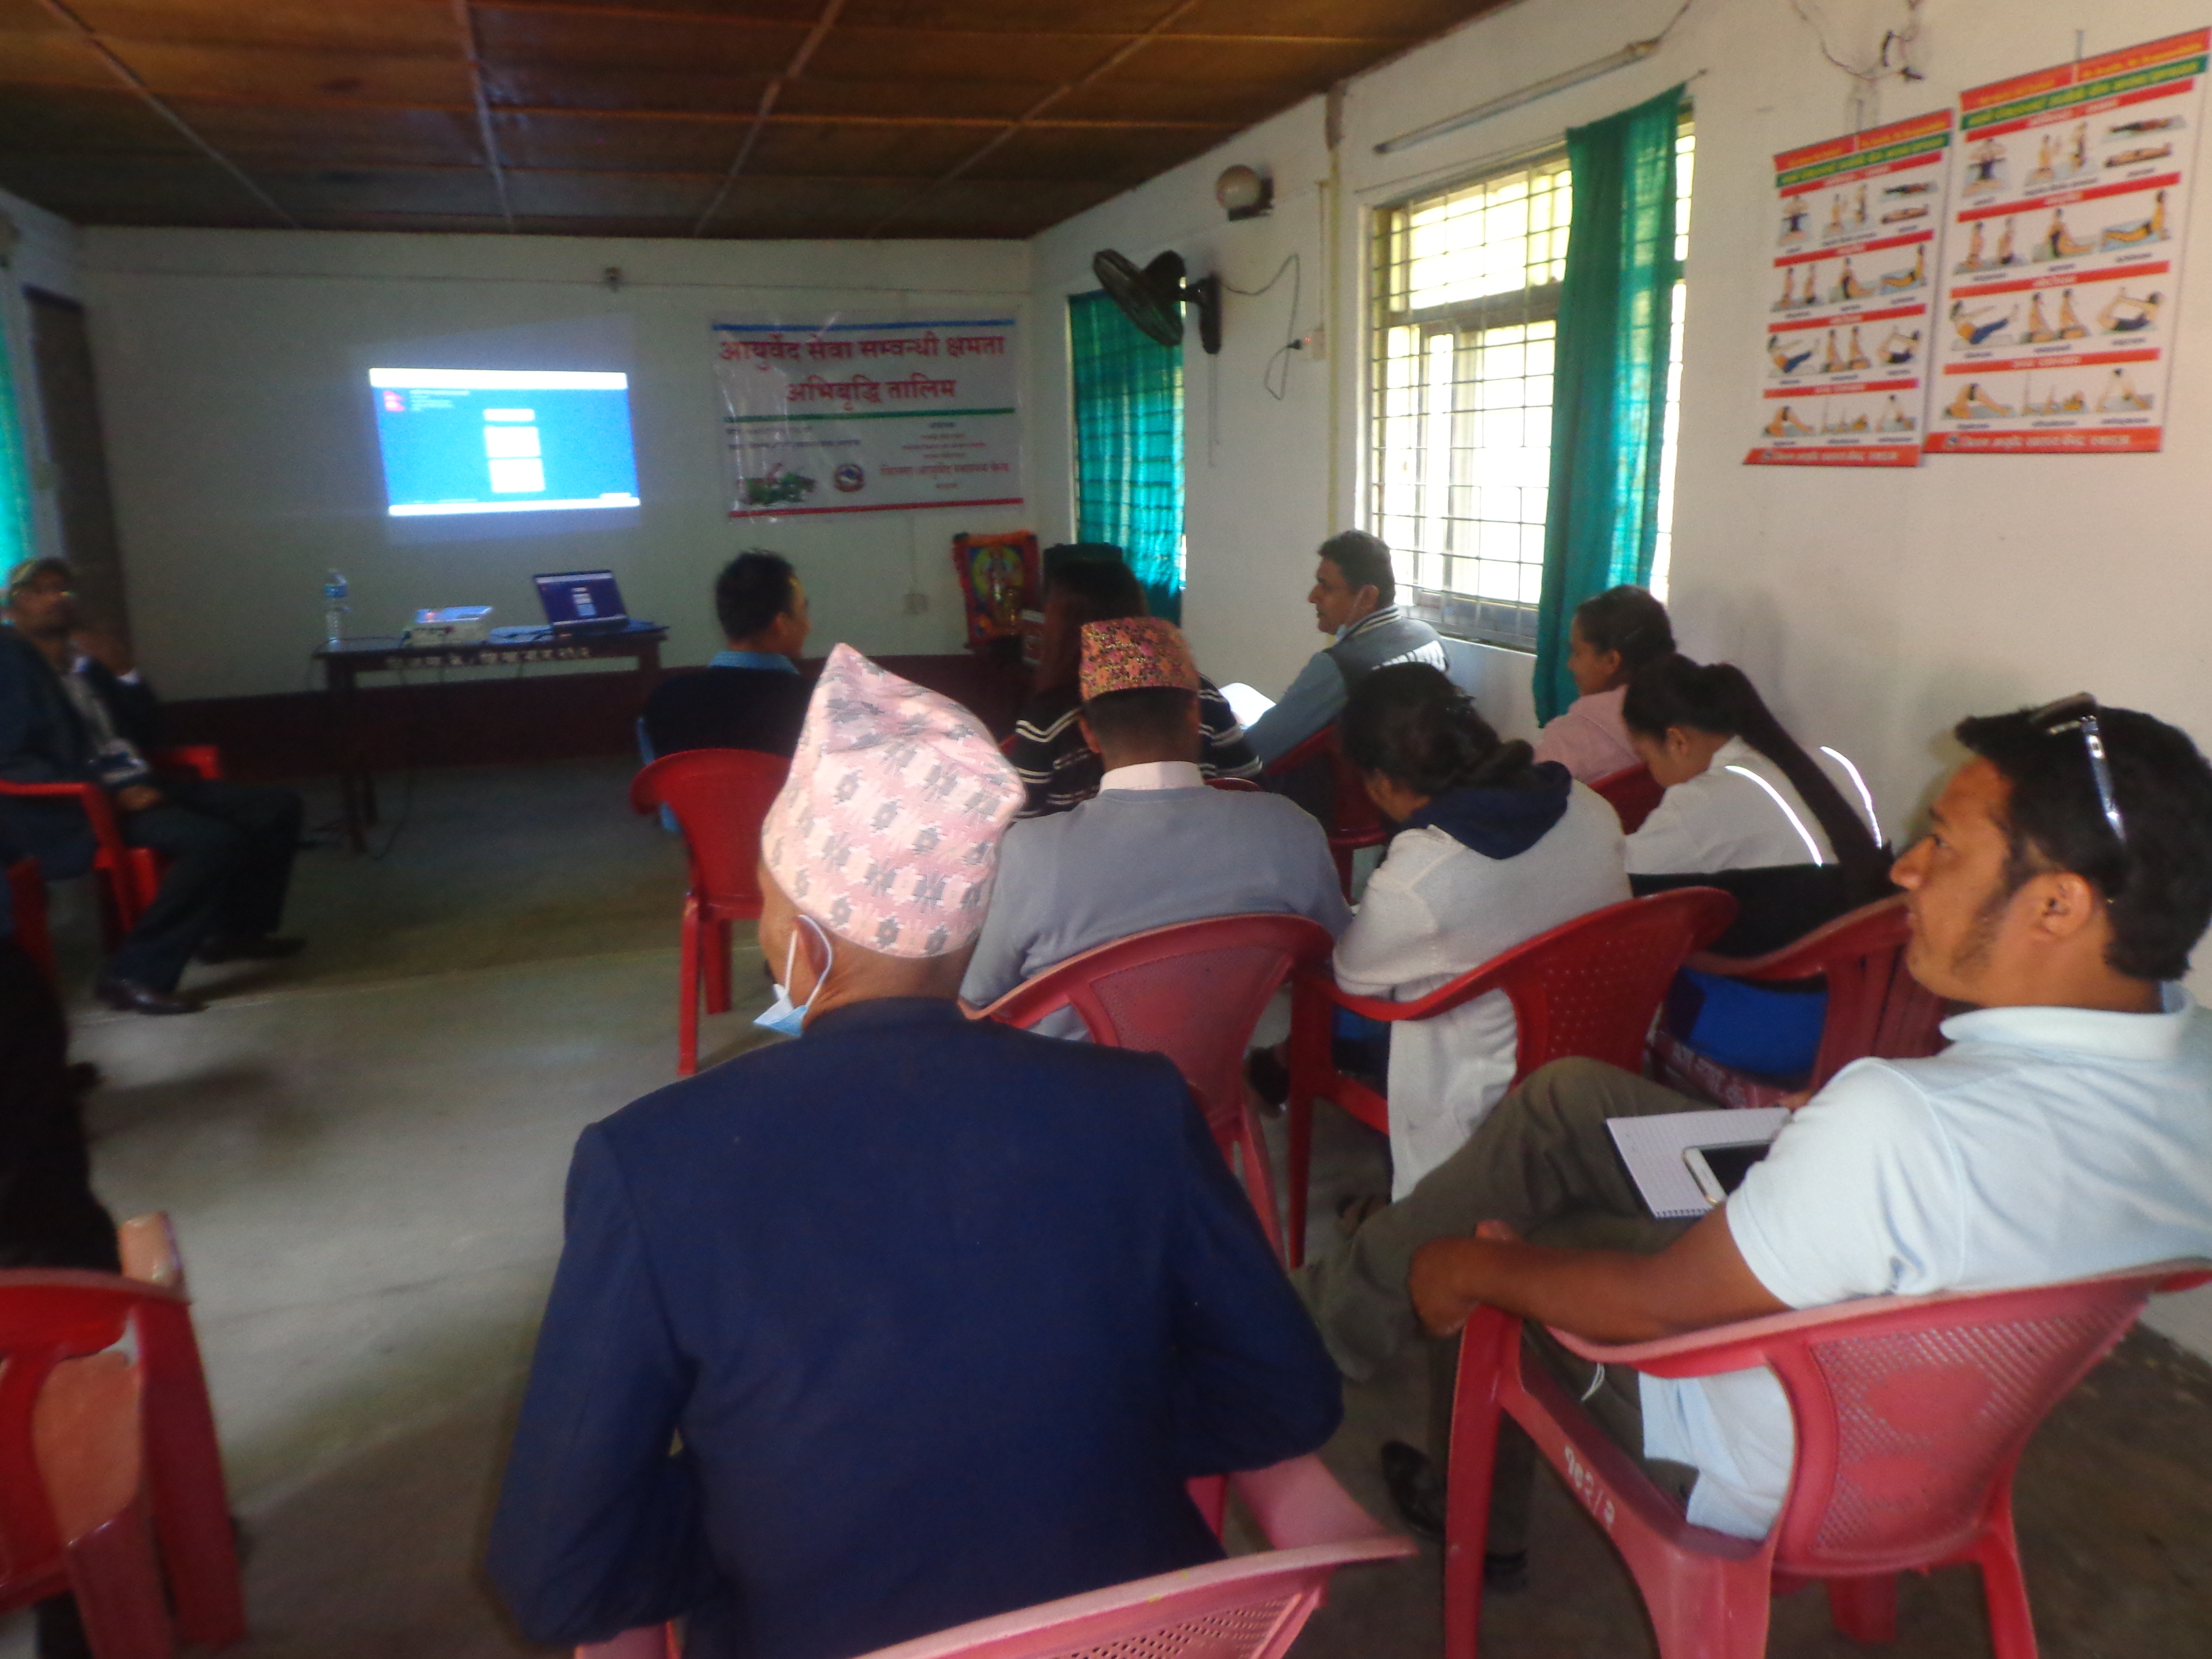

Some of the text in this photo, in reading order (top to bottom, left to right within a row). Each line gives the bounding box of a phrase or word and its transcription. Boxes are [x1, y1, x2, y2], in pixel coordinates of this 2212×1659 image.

[806, 334, 854, 360] सेवा
[947, 336, 1005, 357] क्षमता
[885, 372, 957, 398] तालिम
